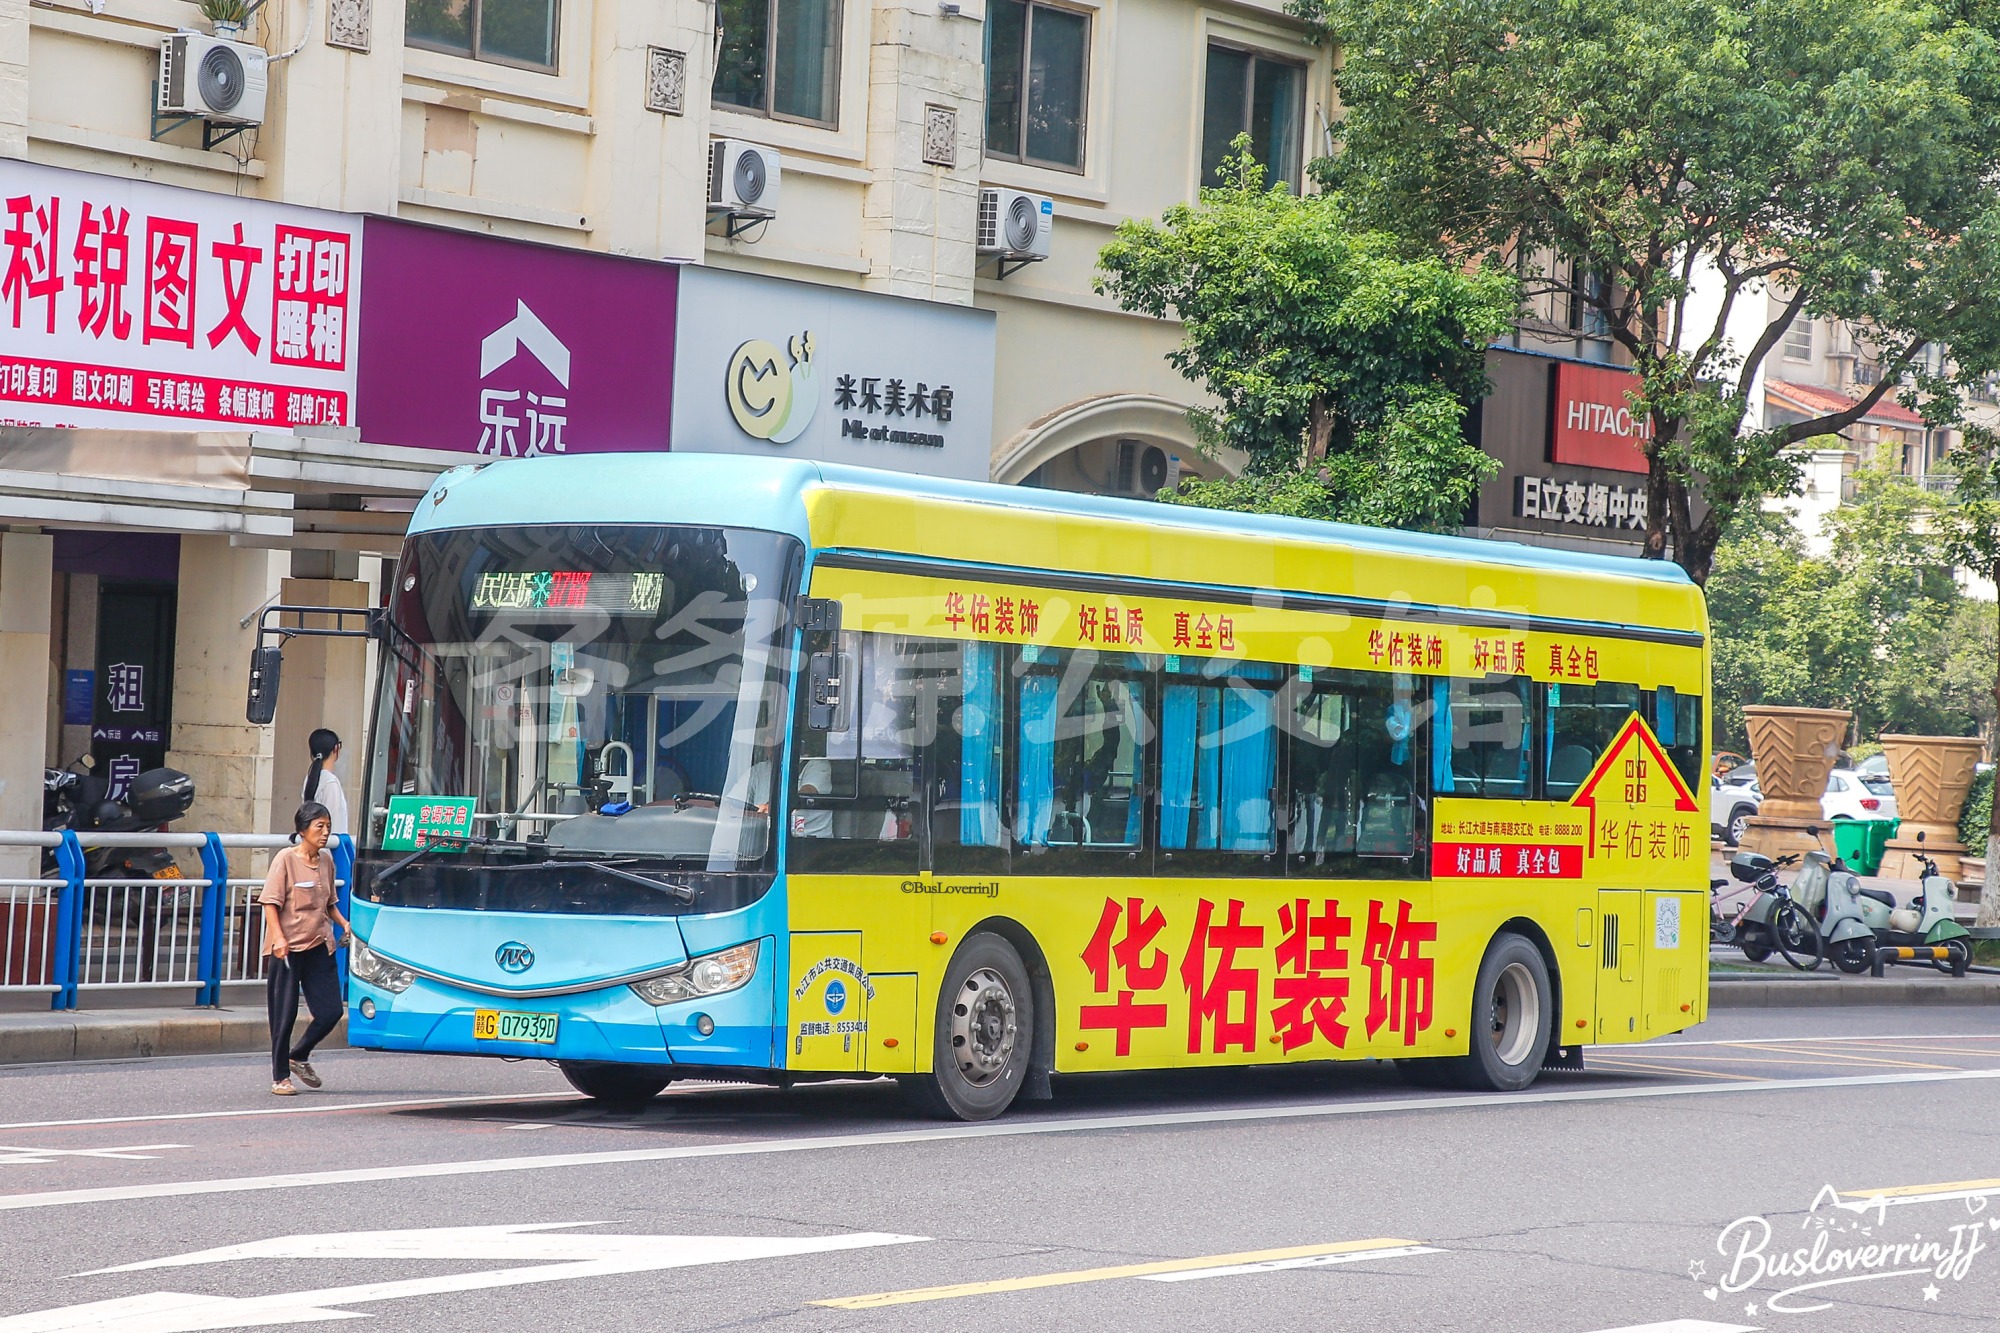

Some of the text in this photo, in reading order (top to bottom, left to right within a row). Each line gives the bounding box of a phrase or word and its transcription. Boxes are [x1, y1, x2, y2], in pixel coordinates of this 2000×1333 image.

[2, 195, 263, 356] 科锐图文
[279, 234, 344, 297] 打印
[276, 300, 345, 363] 照相
[0, 363, 340, 425] 打印复印 图文印刷 写真喷绘 条幅旗帜 招牌门头
[834, 374, 953, 421] 米乐美术馆
[477, 388, 567, 457] 乐远
[1567, 400, 1650, 440] HITACHI
[945, 592, 1235, 651] 华佑装饰 好品质 真全包
[1368, 629, 1600, 680] 华佑装饰 好品质 真全包
[107, 662, 145, 713] 租
[389, 814, 415, 840] 37路
[419, 806, 468, 825] 空调开启
[1600, 820, 1690, 861] 华佑装饰
[1457, 847, 1561, 874] 好品质 真全包
[794, 957, 876, 1001] 九江市公共交通集团公司
[1079, 896, 1437, 1057] 华佑装饰
